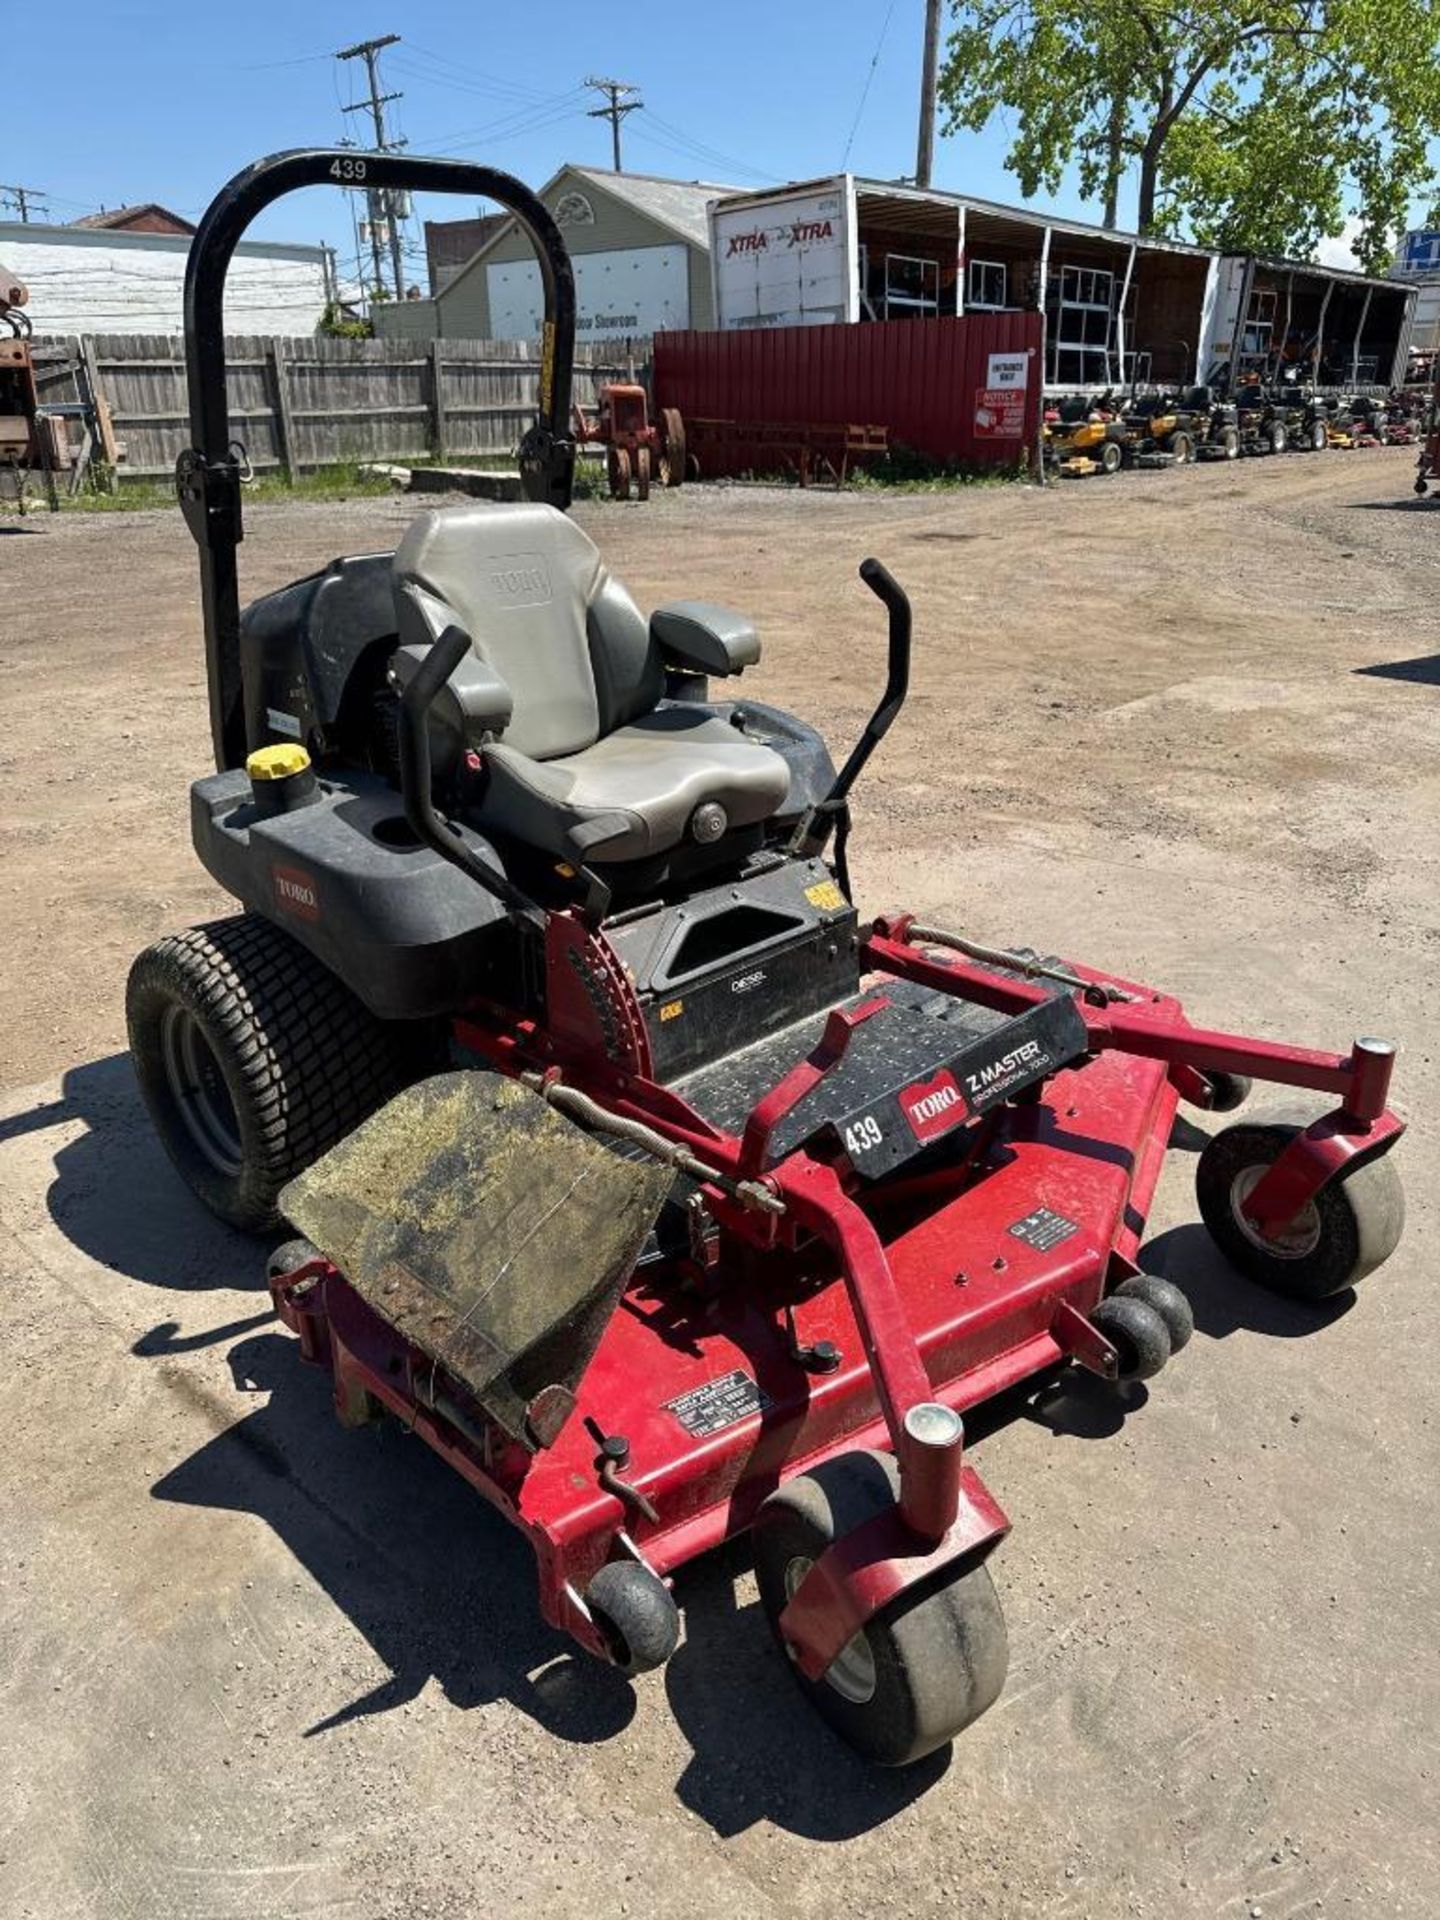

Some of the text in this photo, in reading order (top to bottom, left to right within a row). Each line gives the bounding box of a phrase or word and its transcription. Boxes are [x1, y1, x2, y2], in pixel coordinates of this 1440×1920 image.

[330, 159, 366, 179] 439
[726, 232, 767, 258] XTRA
[787, 221, 832, 248] XTRA
[595, 314, 637, 329] Showroom
[983, 391, 1017, 402] NOTICE
[277, 877, 317, 907] TORO
[731, 971, 767, 991] DIESEL
[966, 1040, 1040, 1092] Z MASTER
[909, 1086, 962, 1124] TORO
[845, 1115, 882, 1154] 439
